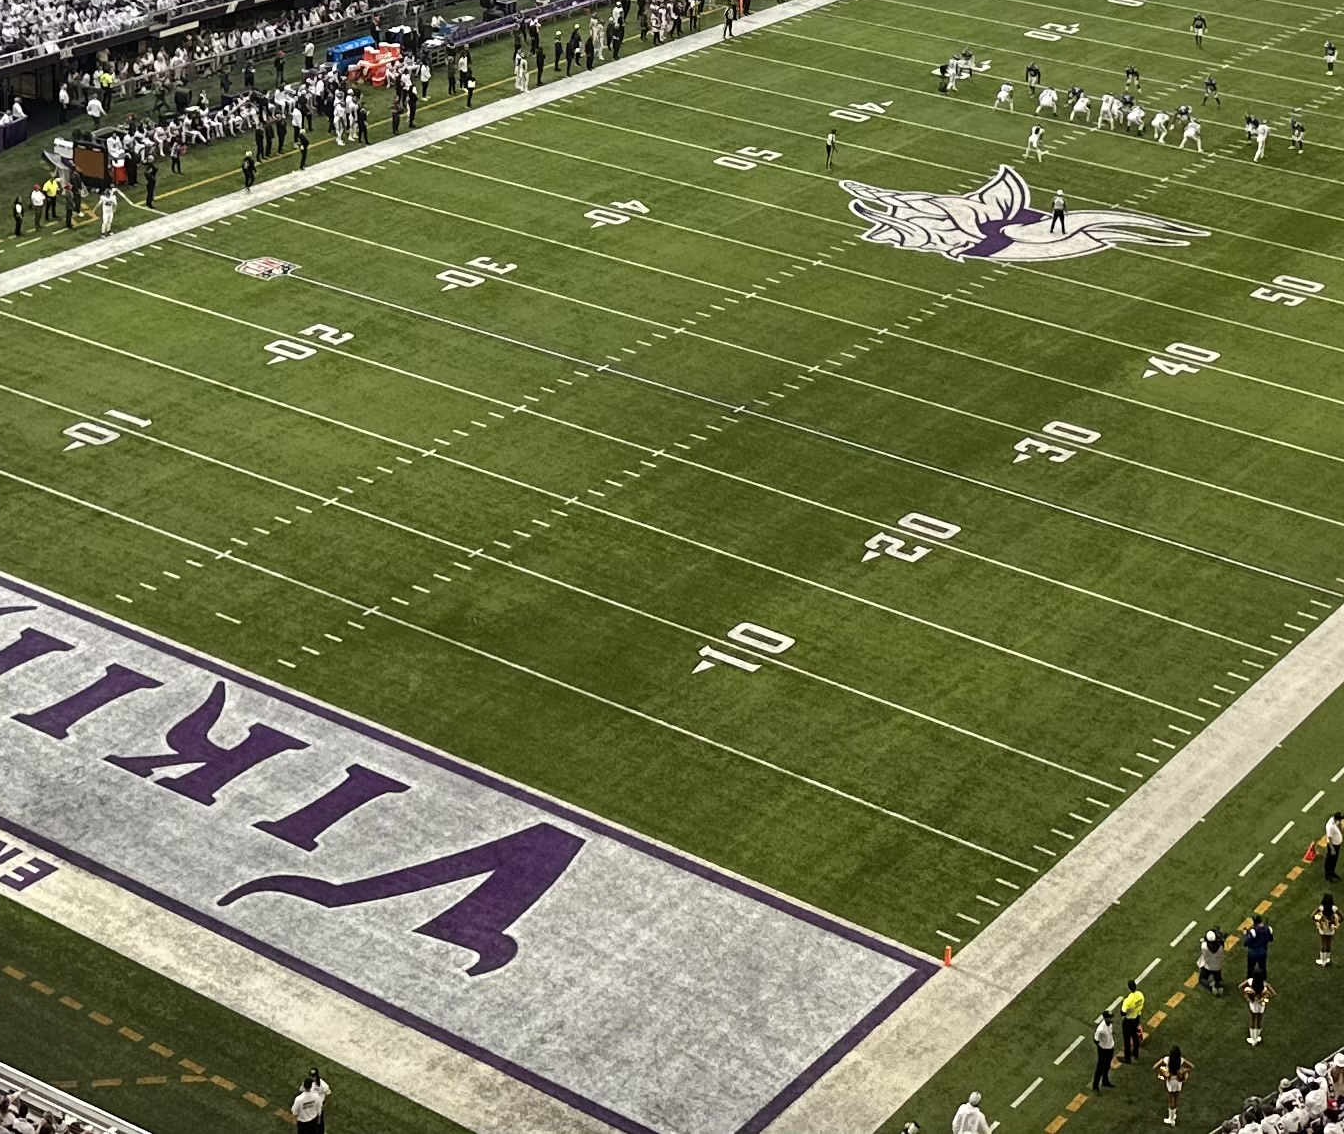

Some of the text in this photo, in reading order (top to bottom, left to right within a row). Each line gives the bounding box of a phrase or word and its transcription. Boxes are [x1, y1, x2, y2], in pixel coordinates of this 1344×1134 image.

[1023, 22, 1081, 42] 20
[713, 145, 782, 171] 50
[584, 199, 651, 227] 40
[444, 254, 518, 287] 30
[1249, 274, 1325, 307] 50
[268, 322, 355, 361] 20
[1151, 341, 1222, 378] 40
[1017, 419, 1102, 464] 30
[867, 511, 963, 564] 20
[699, 620, 795, 673] 10
